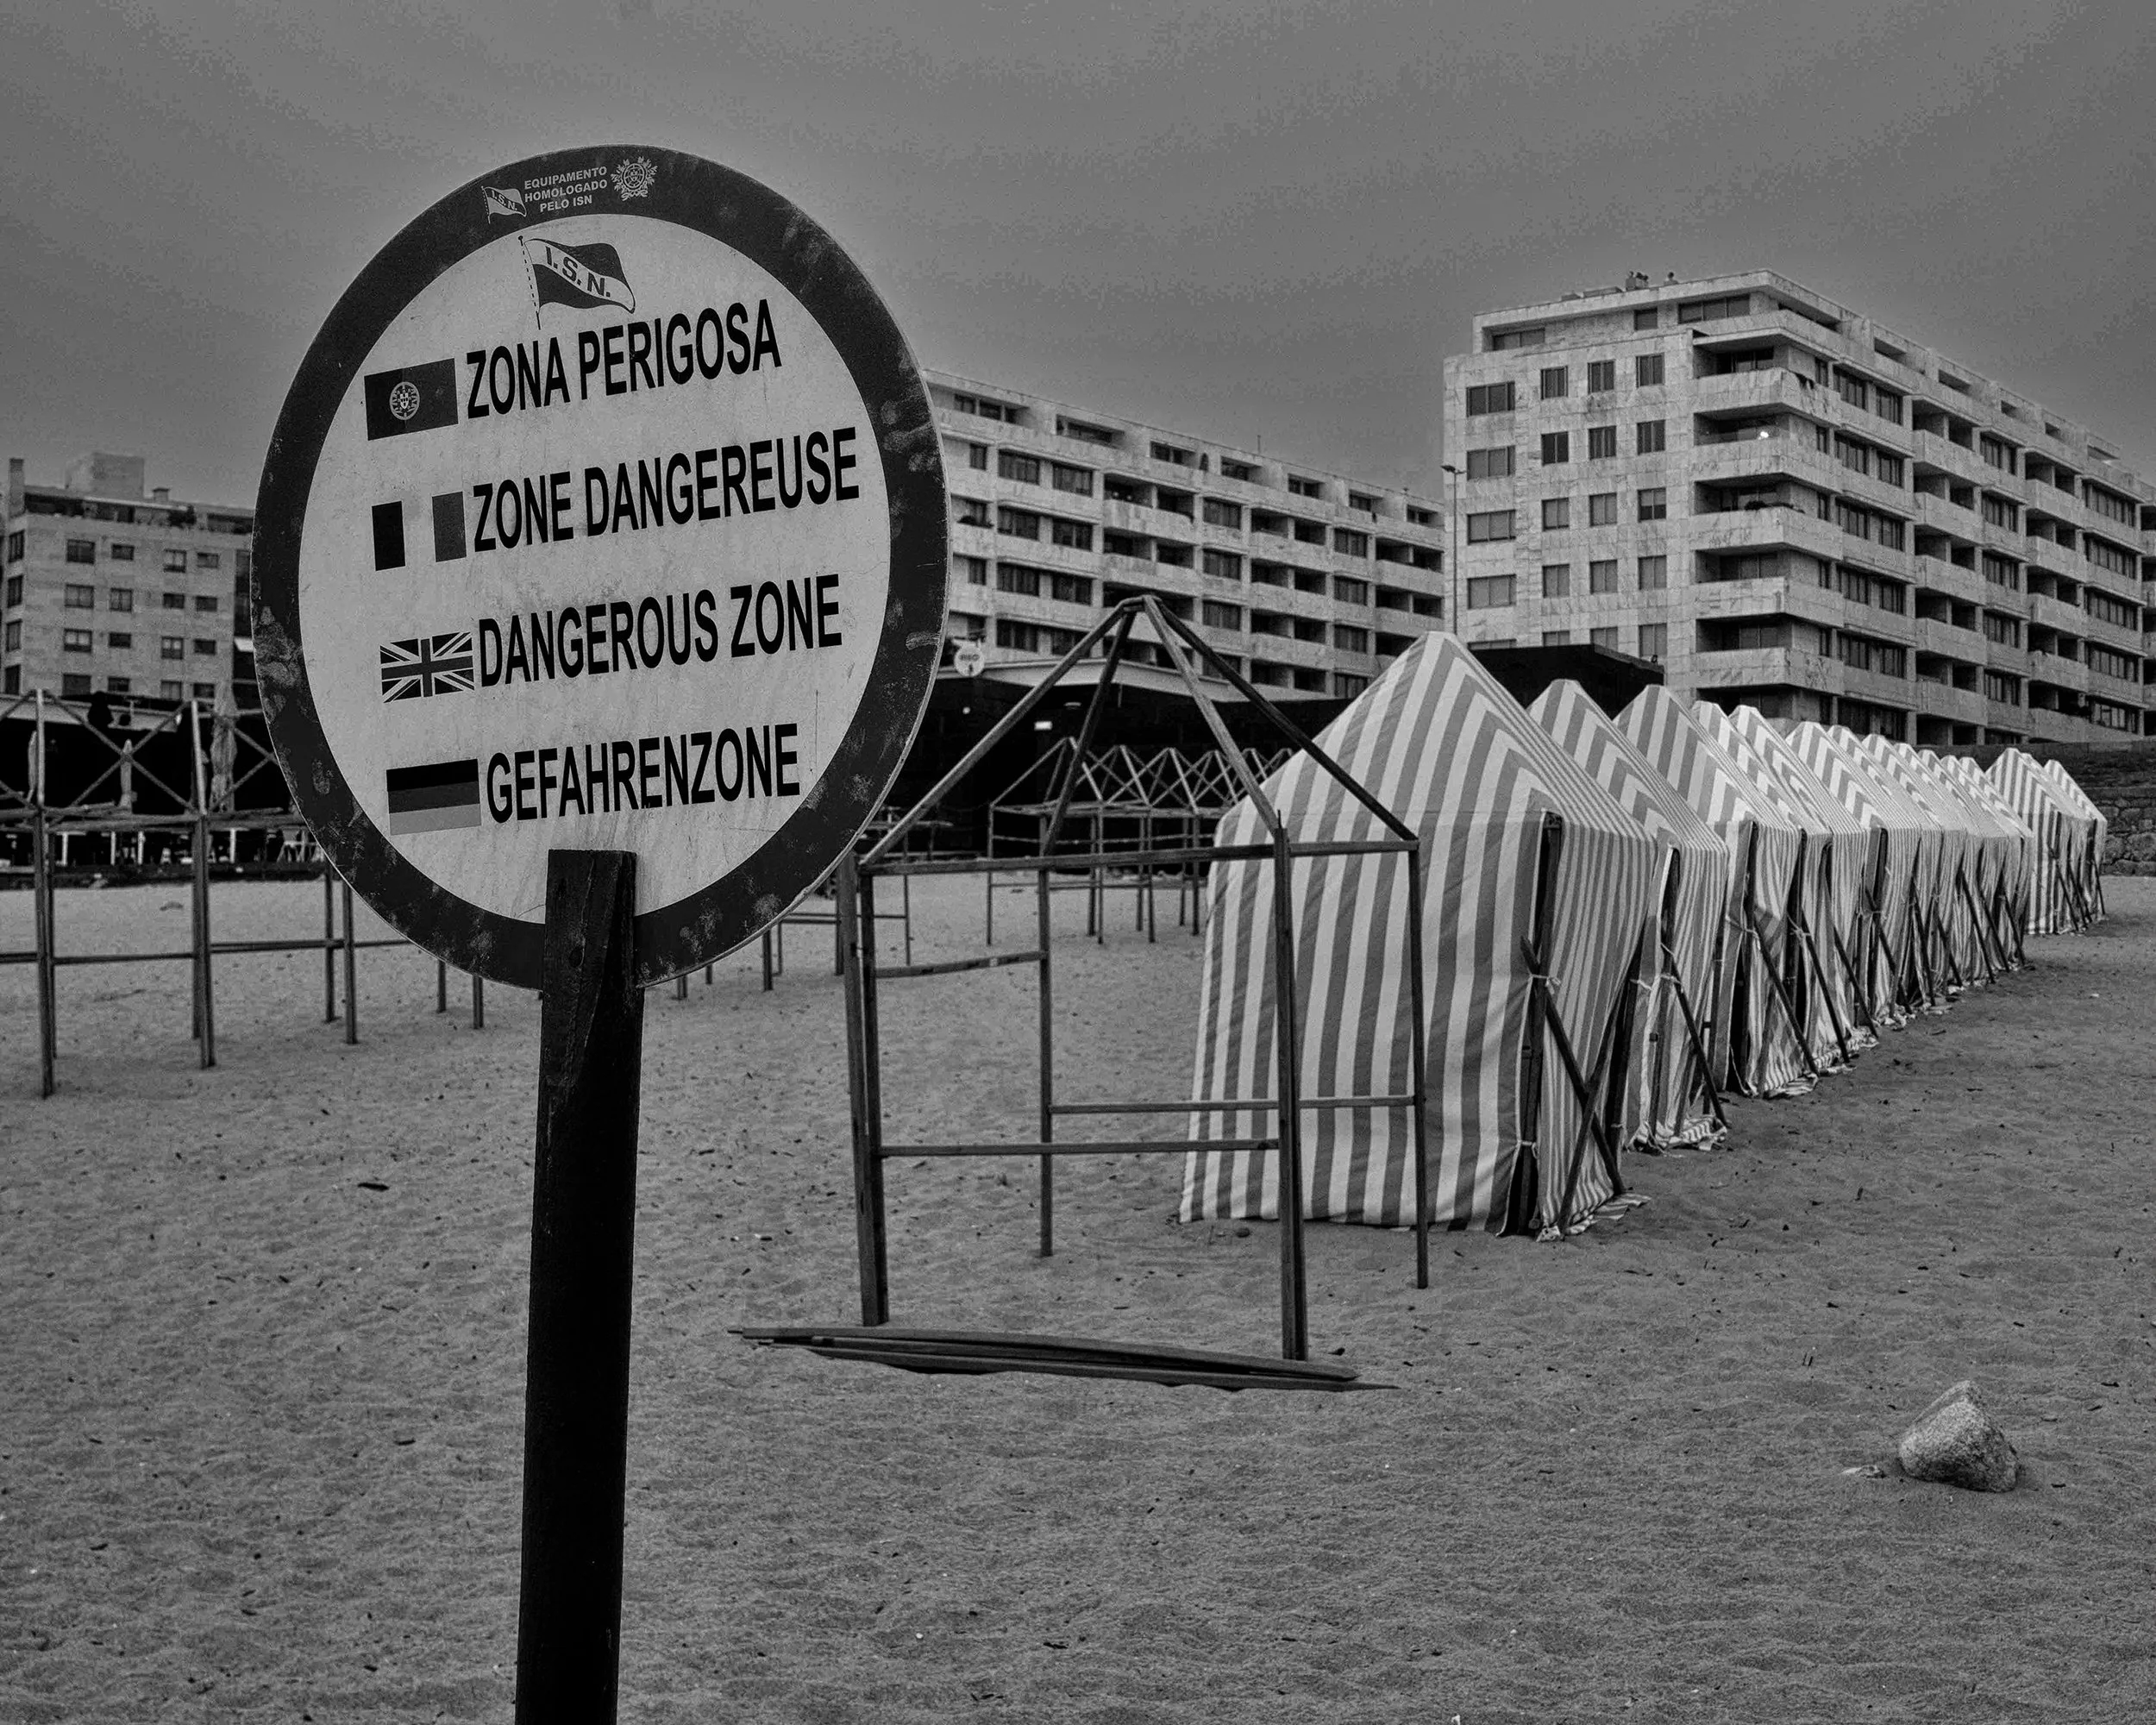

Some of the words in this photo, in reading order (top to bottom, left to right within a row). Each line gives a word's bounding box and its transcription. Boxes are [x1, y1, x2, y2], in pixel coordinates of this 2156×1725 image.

[524, 166, 607, 190] EQUIPAMENTO
[524, 179, 608, 203] HOMOLOGADO
[540, 198, 570, 213] PELO
[573, 195, 592, 207] ISN
[545, 246, 611, 298] I.S.N.
[466, 336, 571, 419] ZONA
[579, 298, 782, 400] PERIGOSA
[473, 471, 574, 553] ZONE
[584, 426, 860, 537] DANGEREUSE
[479, 589, 718, 688] DANGEROUS
[730, 574, 843, 660] ZONE
[486, 723, 800, 824] GEFAHRENZONE
